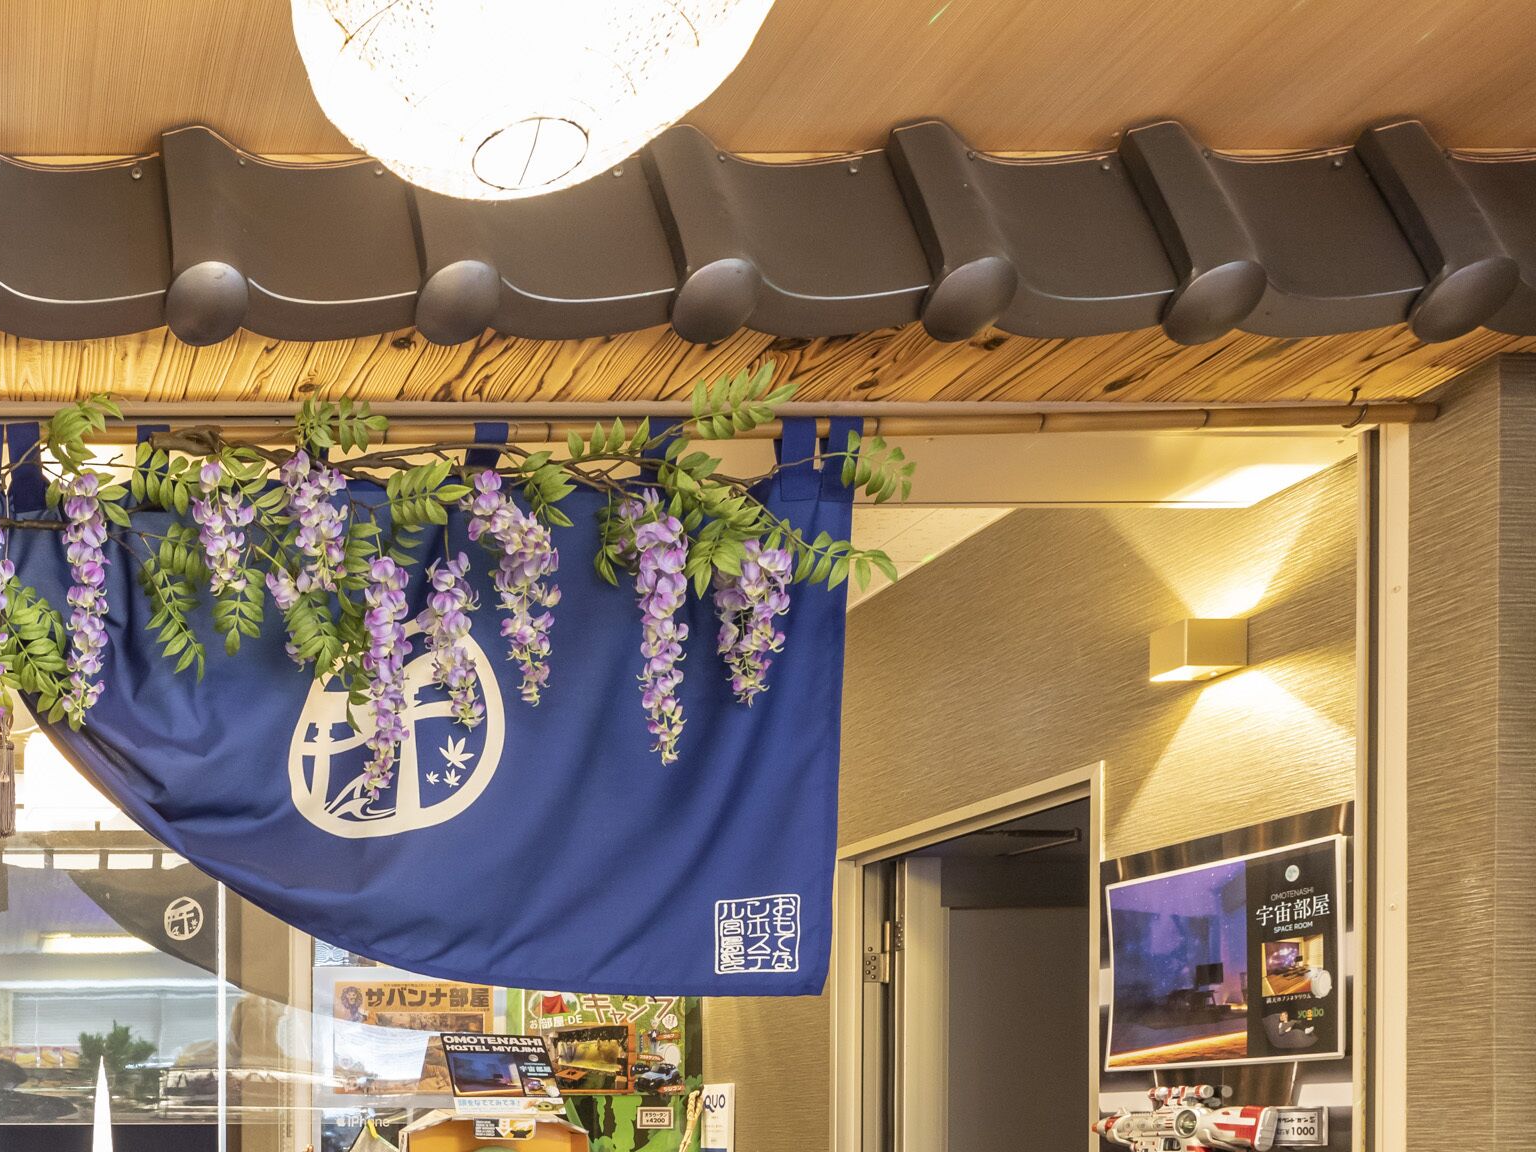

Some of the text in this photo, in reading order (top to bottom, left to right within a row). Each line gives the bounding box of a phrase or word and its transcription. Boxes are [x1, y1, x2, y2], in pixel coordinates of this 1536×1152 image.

[1271, 887, 1314, 901] OMOTENASHI
[1256, 893, 1331, 927] 宇宙部屋
[1274, 921, 1313, 933] SPACE ROOM
[365, 987, 490, 1008] サバンナ部屋
[1298, 1007, 1324, 1020] yogibo
[443, 1035, 543, 1046] OMOTENASHI
[446, 1044, 489, 1052] HOSTEL
[704, 1094, 726, 1112] QUO
[347, 1115, 390, 1128] iPhne
